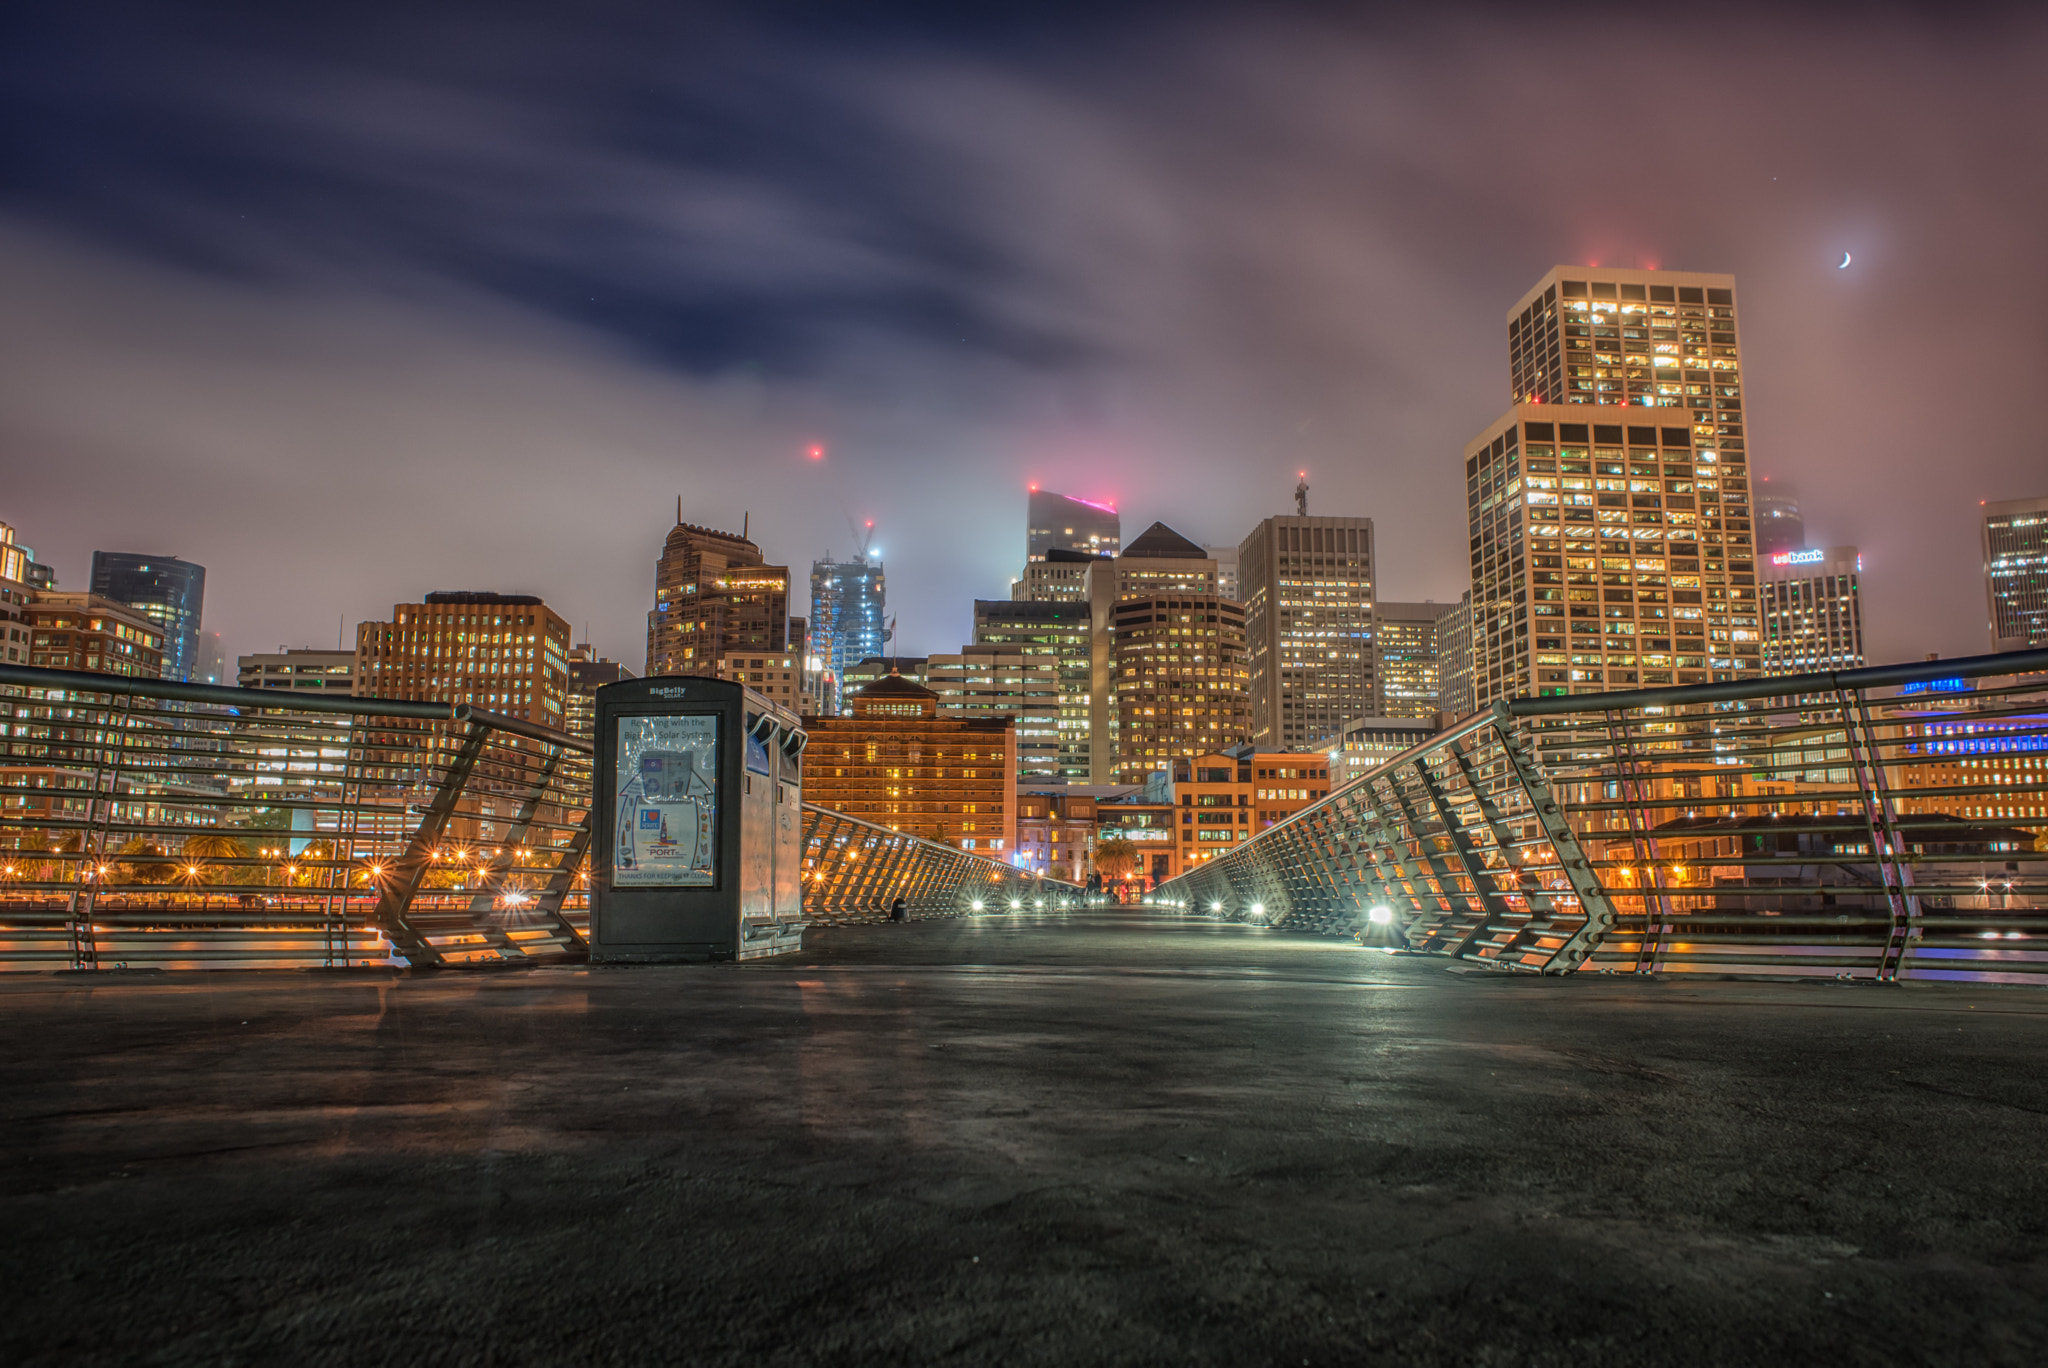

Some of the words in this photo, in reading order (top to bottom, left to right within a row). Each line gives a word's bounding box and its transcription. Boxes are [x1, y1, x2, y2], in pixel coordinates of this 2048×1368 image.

[649, 687, 686, 696] BigBelly
[631, 719, 669, 728] Recyling
[671, 719, 690, 727] with
[692, 718, 705, 727] the
[659, 731, 680, 739] Solar
[681, 731, 711, 741] System
[650, 848, 676, 856] PORT
[618, 872, 642, 880] THANKS
[643, 872, 656, 880] FOR
